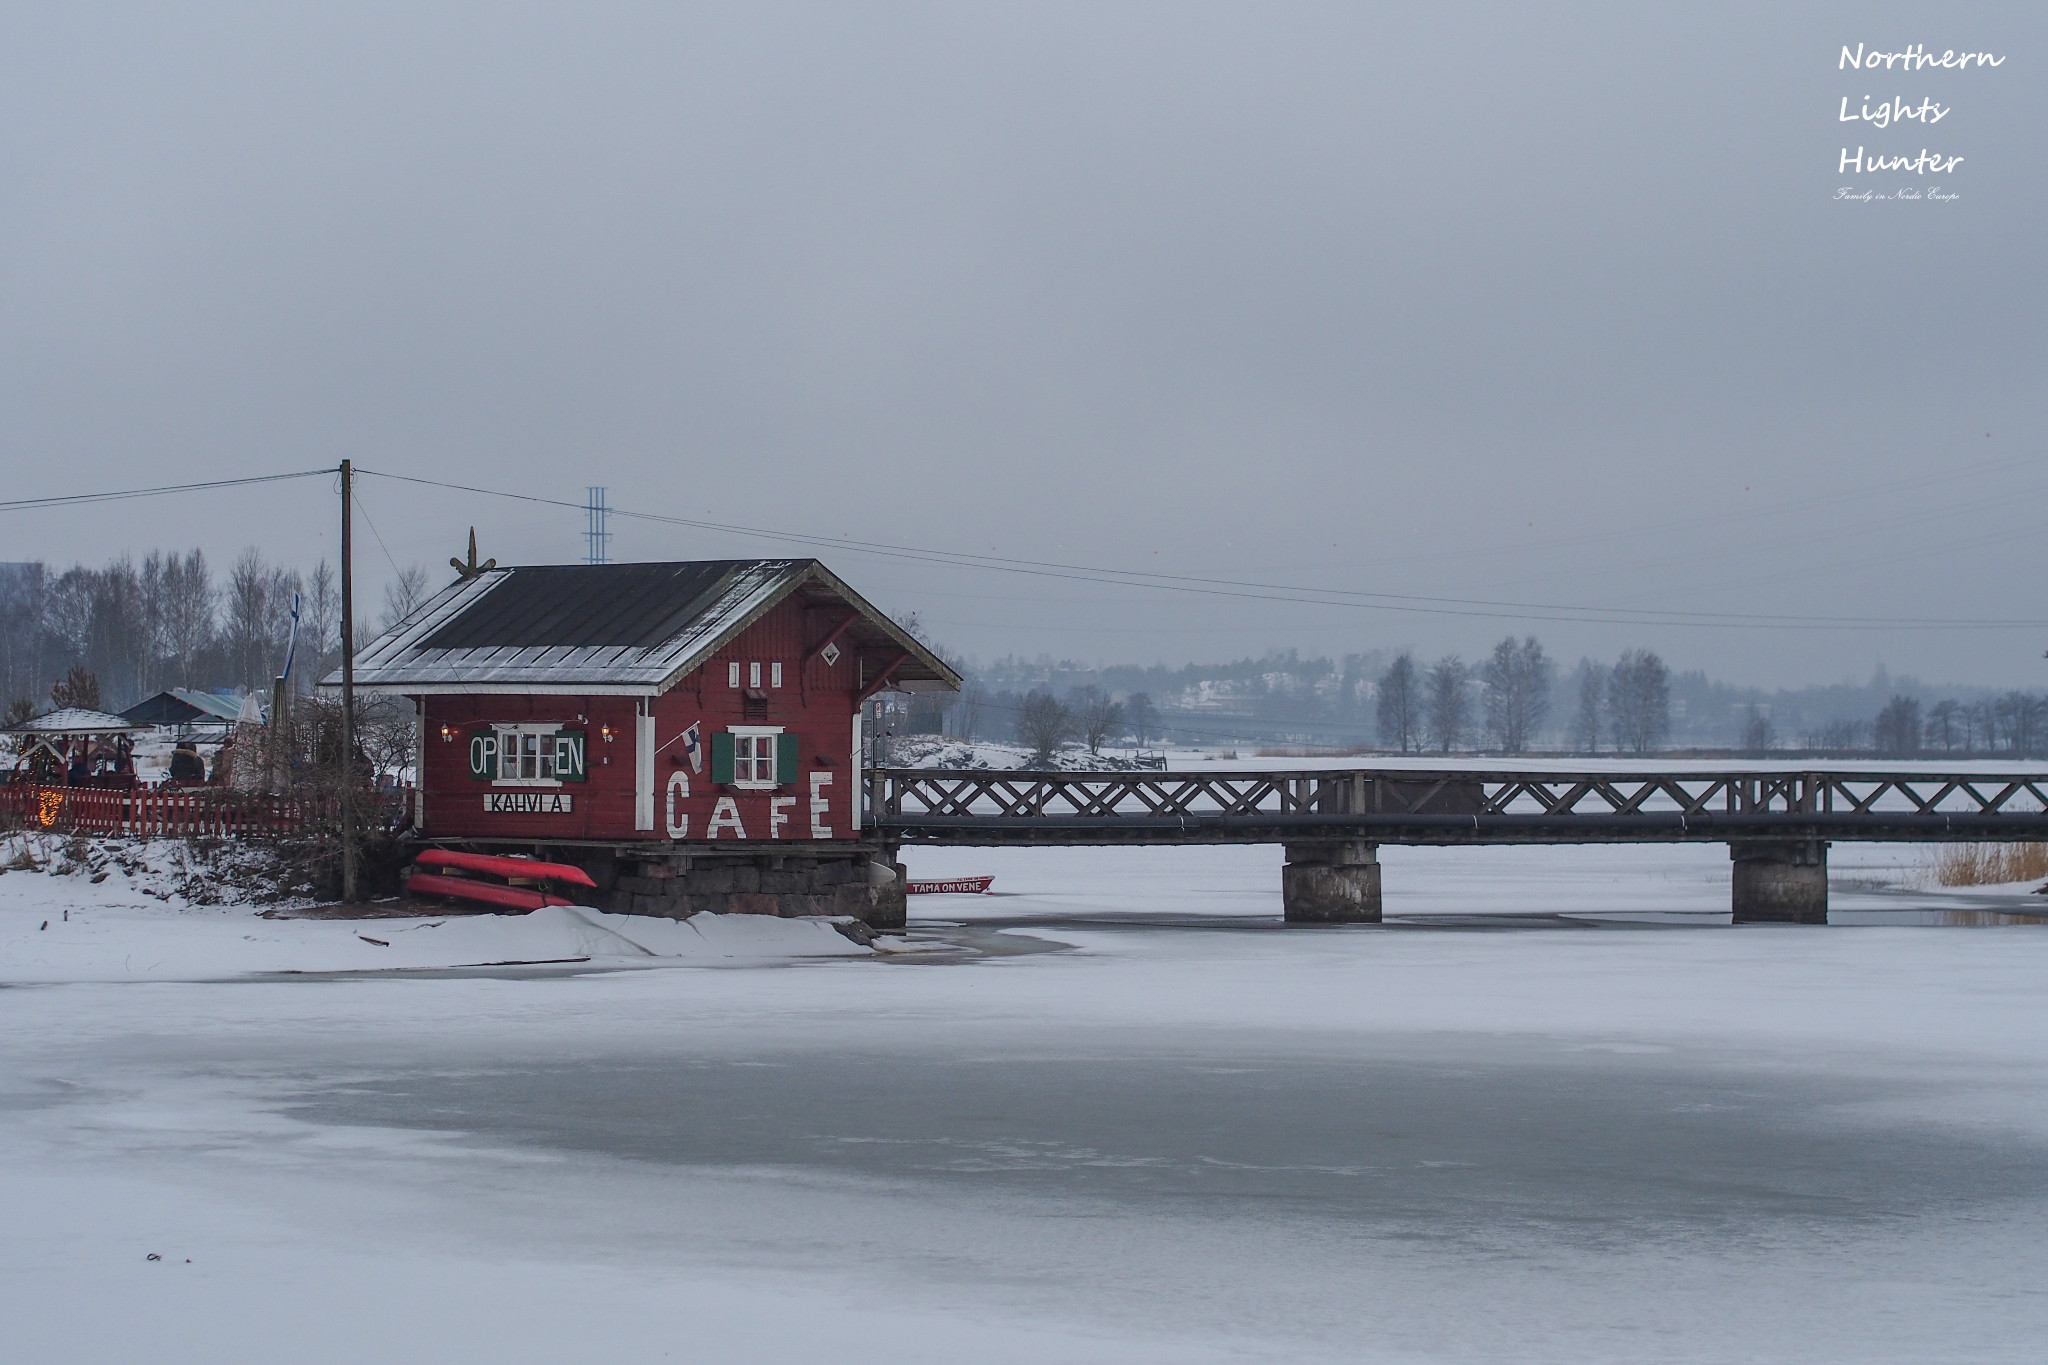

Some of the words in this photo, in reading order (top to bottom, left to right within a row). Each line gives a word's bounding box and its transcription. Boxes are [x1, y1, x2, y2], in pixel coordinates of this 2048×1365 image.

[666, 770, 833, 839] CAFE
[942, 883, 955, 892] ON
[957, 882, 981, 891] VENE
